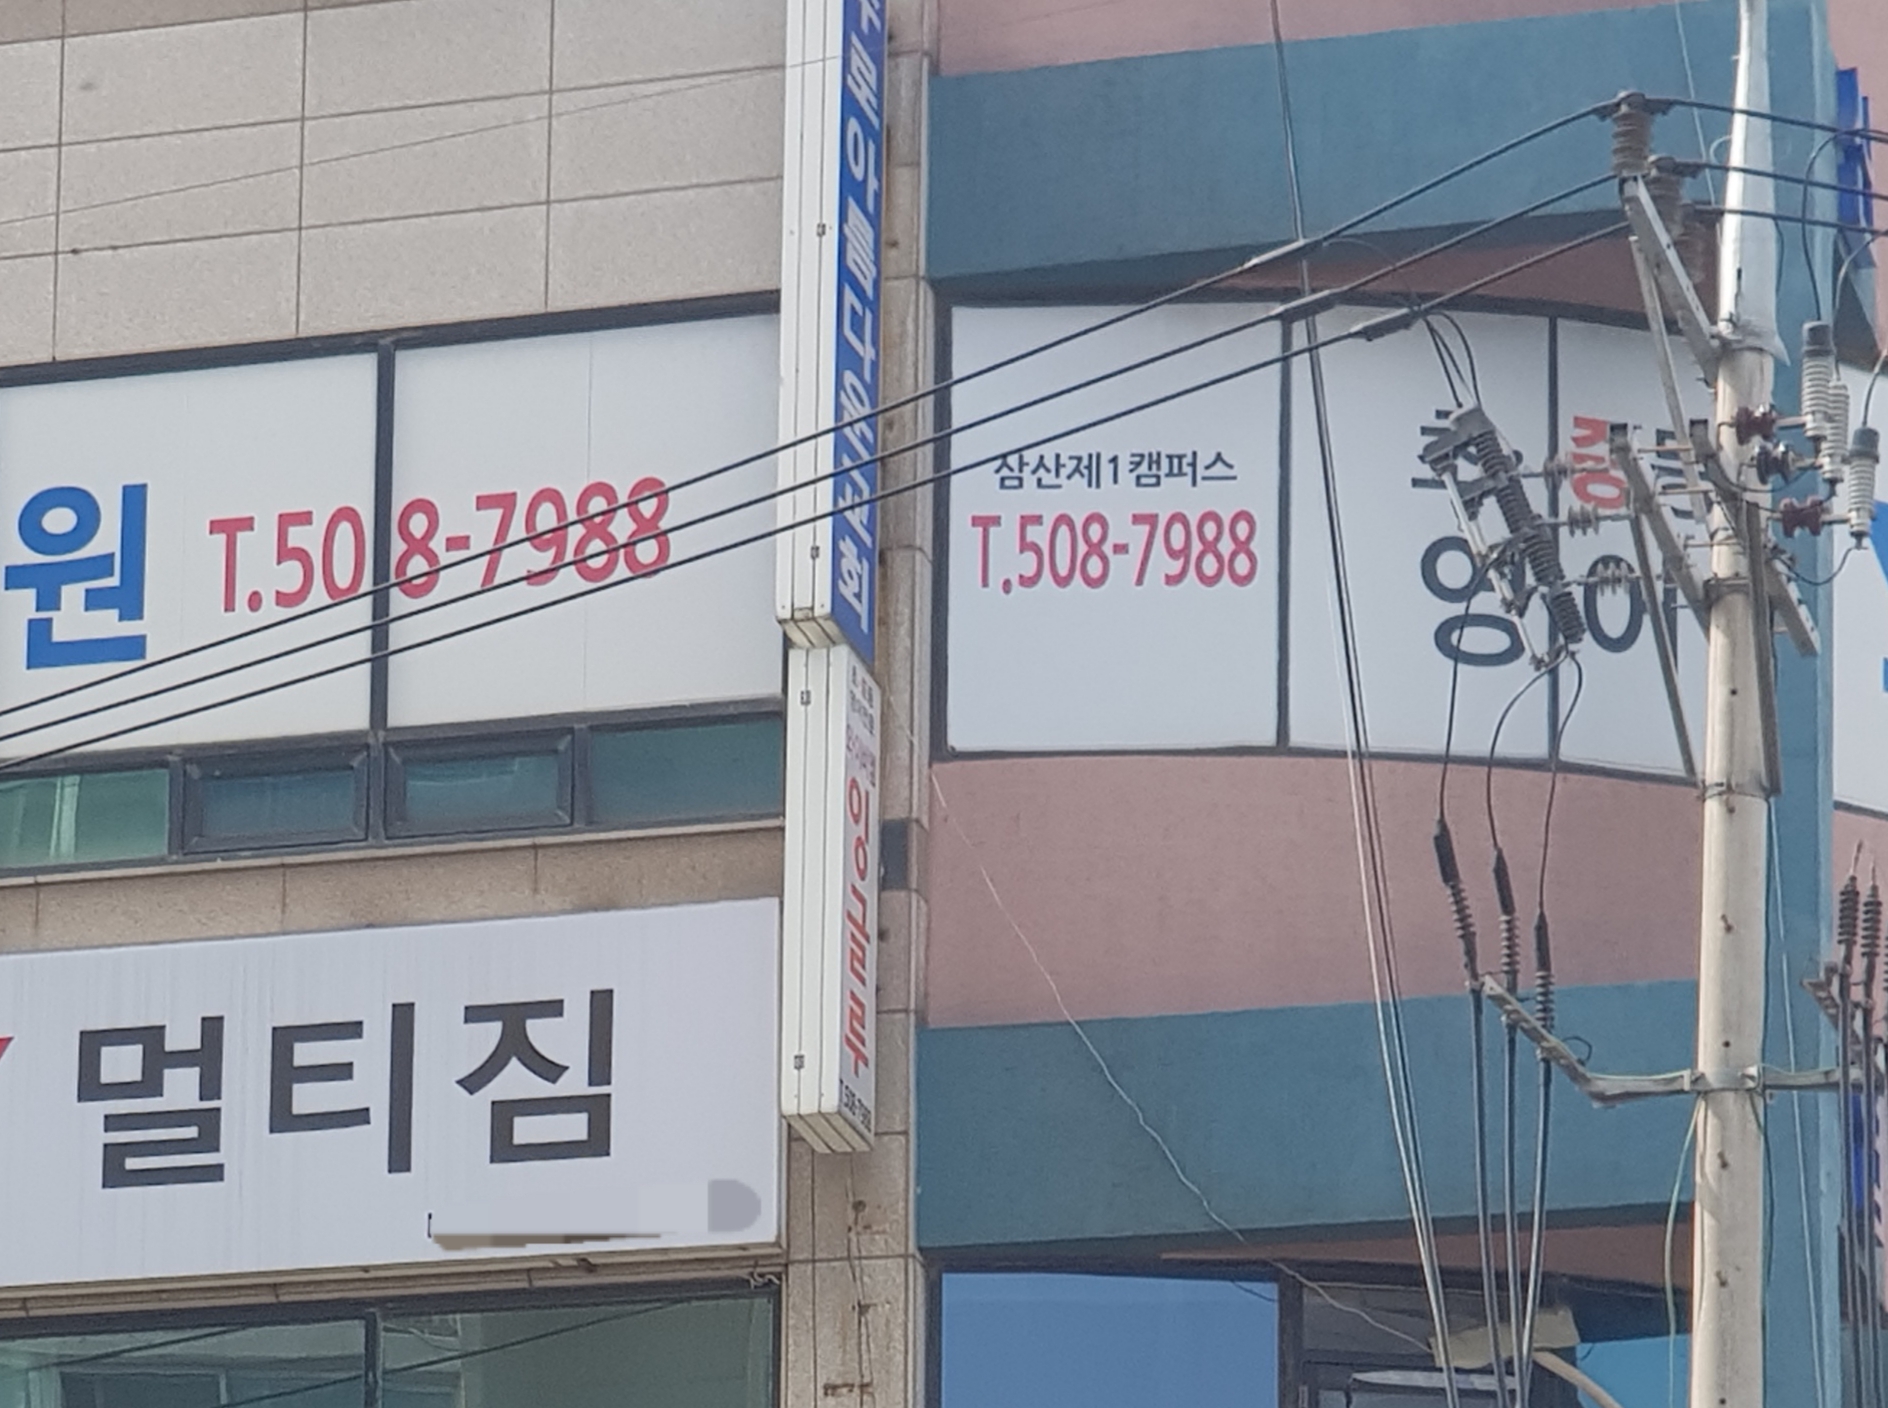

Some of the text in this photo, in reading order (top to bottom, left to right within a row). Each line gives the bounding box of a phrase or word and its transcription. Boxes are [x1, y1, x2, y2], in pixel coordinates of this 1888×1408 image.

[993, 450, 1238, 491] 삼산제1캠퍼스
[970, 509, 1258, 595] T.508-7988
[76, 989, 615, 1190] 멀티짐
